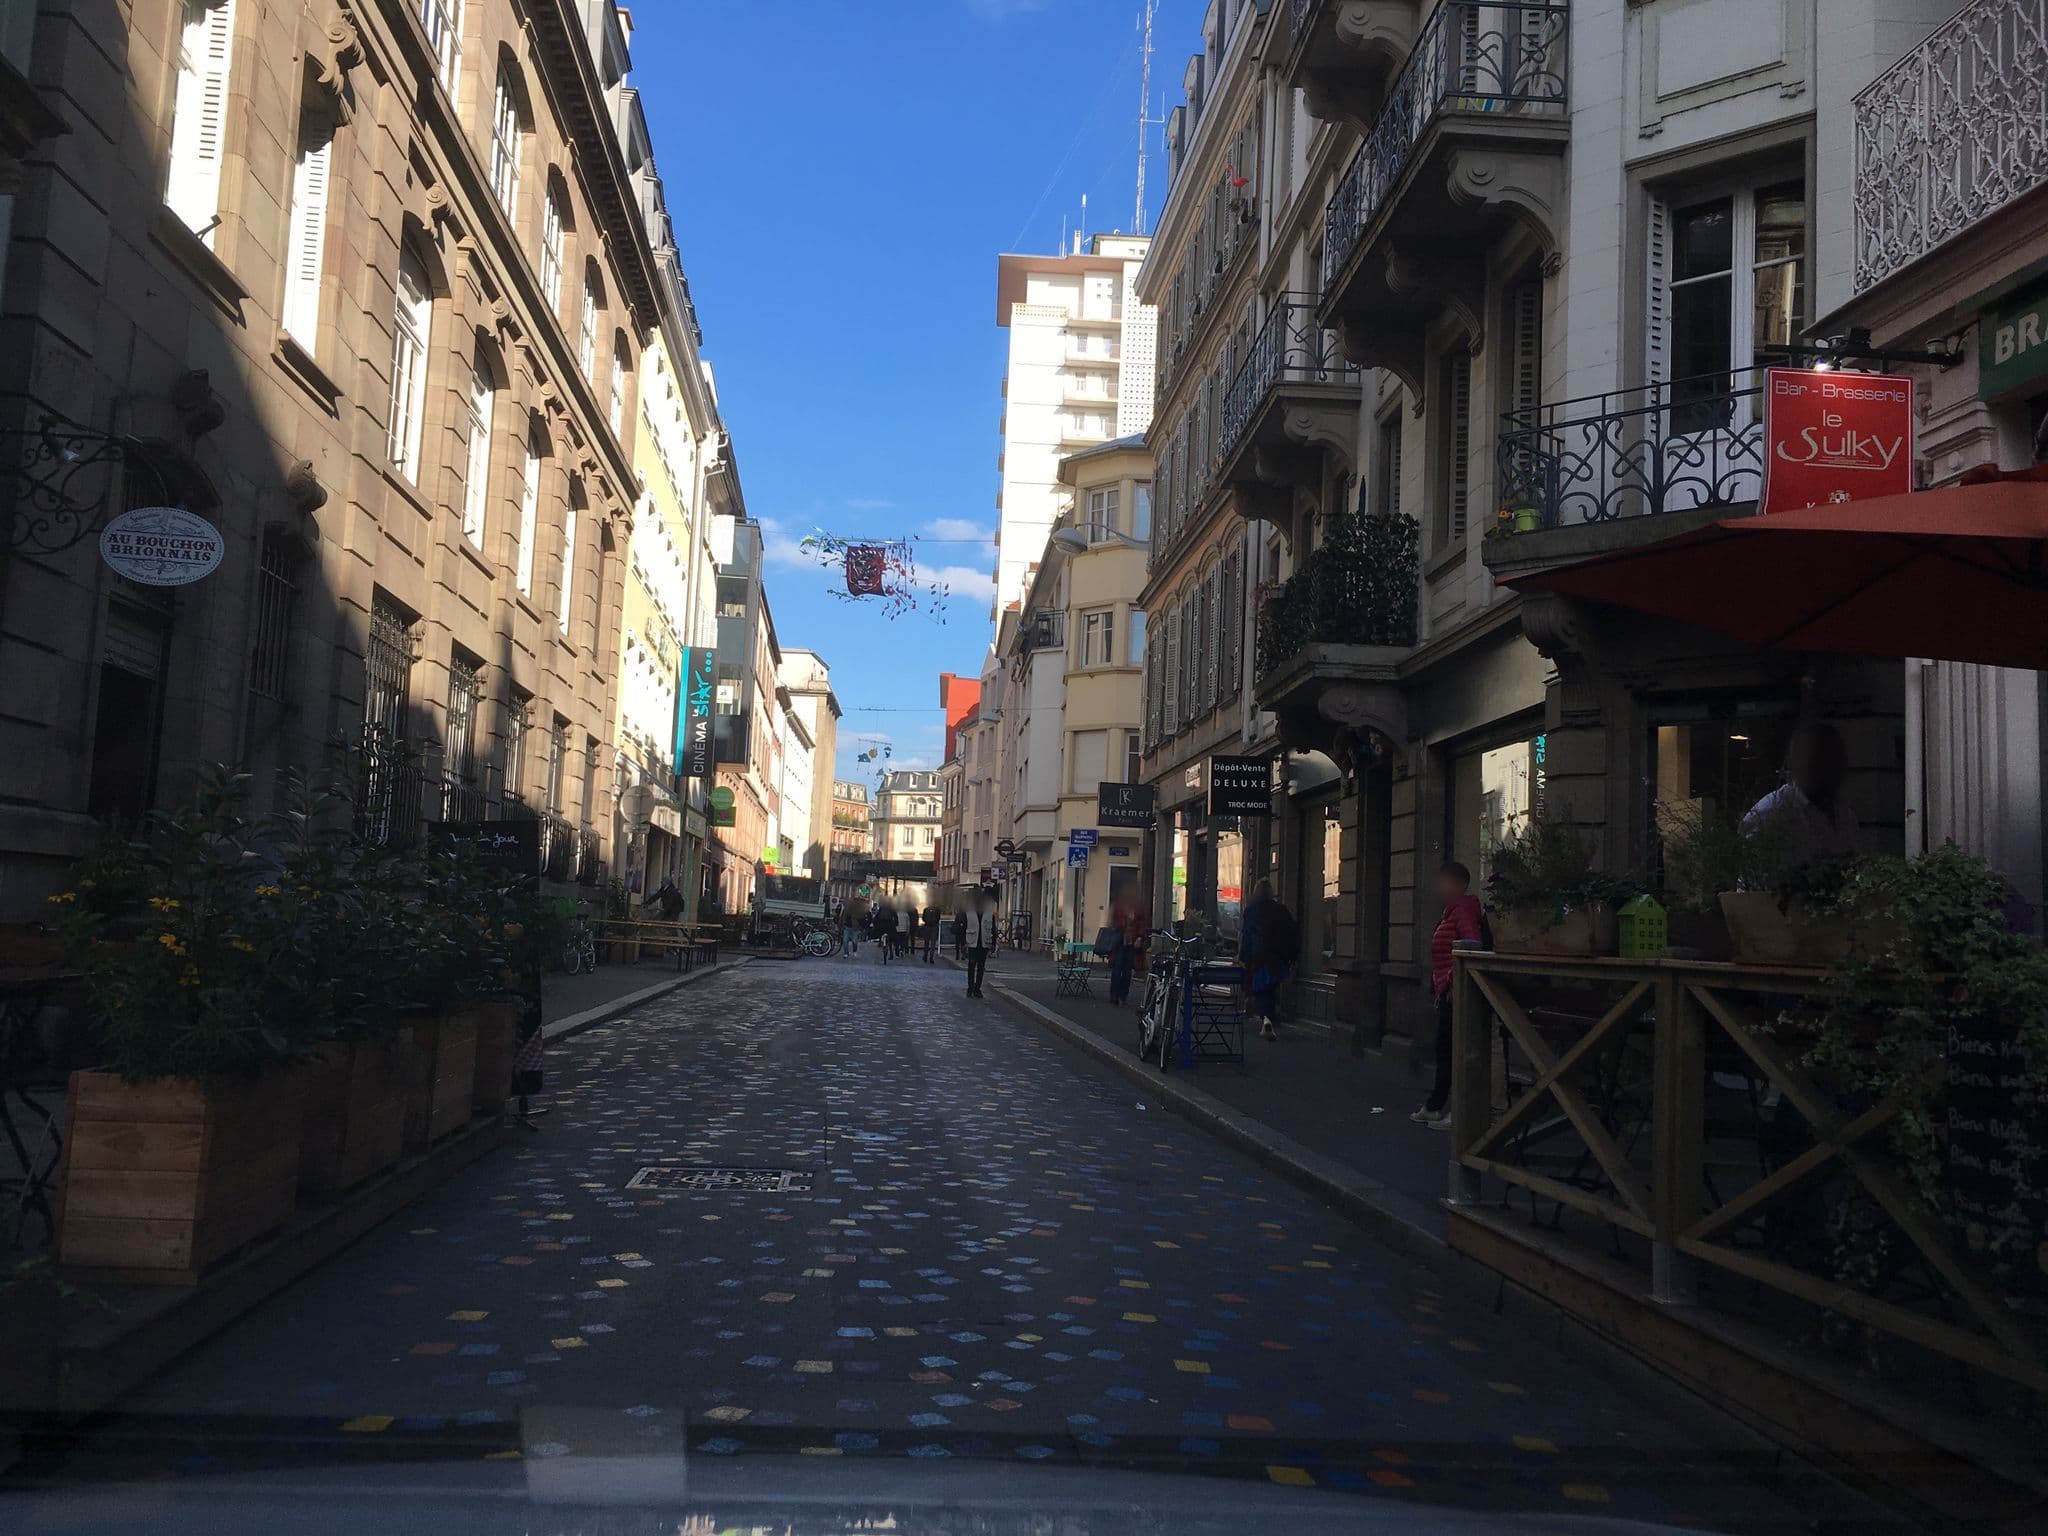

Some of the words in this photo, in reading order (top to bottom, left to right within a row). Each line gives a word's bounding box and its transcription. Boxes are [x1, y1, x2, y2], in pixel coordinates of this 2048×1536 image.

[1994, 312, 2048, 366] BR
[1775, 380, 1808, 397] Bar
[1822, 383, 1906, 403] Brasserie
[1822, 409, 1843, 428] le
[1776, 427, 1904, 470] Sulky
[107, 533, 132, 545] AU
[135, 536, 216, 552] BOUCHON
[110, 544, 212, 562] BRIONNAIS
[693, 721, 708, 774] CINÉMA
[1215, 762, 1266, 773] Dépôt-Vente
[1214, 779, 1267, 788] DELUXE
[1101, 806, 1151, 818] Kraemer
[1247, 801, 1268, 809] MODE
